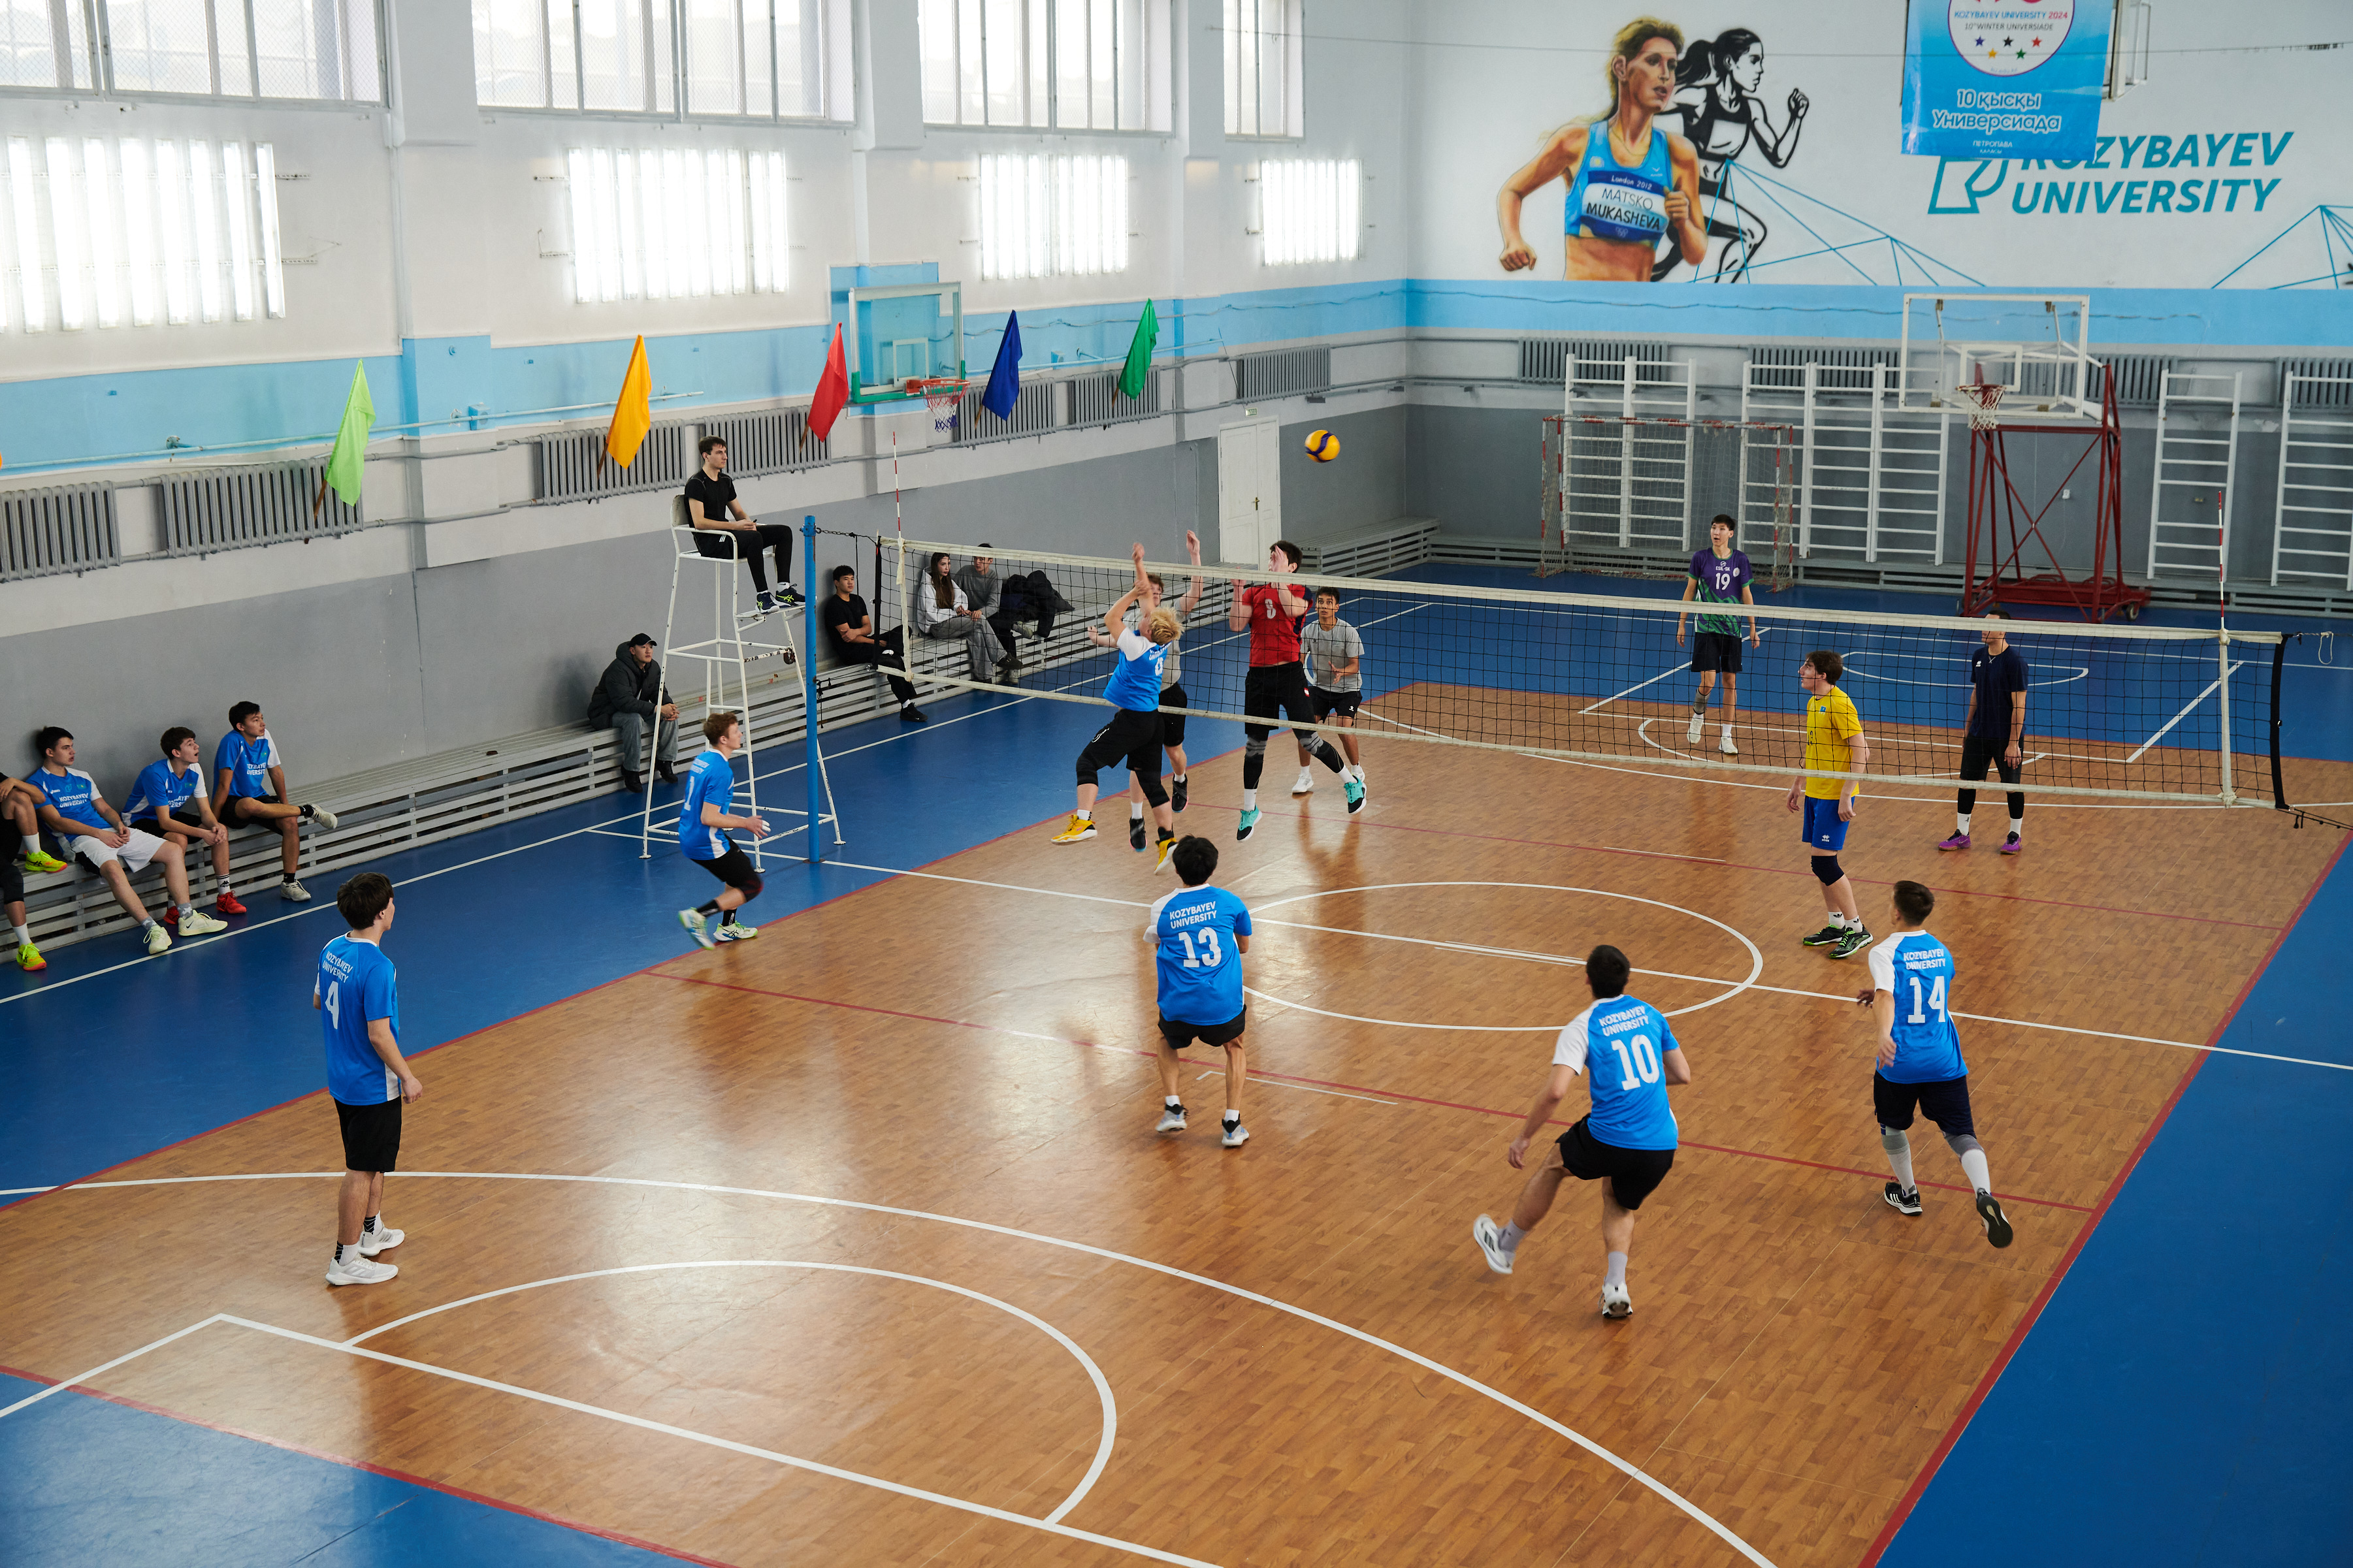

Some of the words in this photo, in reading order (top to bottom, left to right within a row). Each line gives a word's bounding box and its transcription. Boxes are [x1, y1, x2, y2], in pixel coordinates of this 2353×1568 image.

[1955, 10, 1999, 19] KOZYBAYEV
[2048, 11, 2068, 20] 2024
[1958, 89, 1976, 107] 10
[1977, 91, 2041, 111] қысқы
[1932, 109, 2062, 135] Универсиада
[2021, 132, 2294, 169] ZYBAYEV
[1611, 175, 1634, 185] London
[1636, 180, 1652, 190] 2012
[1602, 187, 1653, 210] MATSKO
[2012, 178, 2282, 214] UNIVERSITY
[1586, 202, 1660, 231] MUKASHEVA
[1715, 573, 1730, 590] 19
[1169, 901, 1216, 920] KOZYBAYEV
[1170, 910, 1217, 929] UNIVERSITY
[1178, 927, 1222, 968] 13
[1904, 948, 1944, 961] KOZYBAYEV
[322, 960, 349, 983] UNIVERITY
[1906, 958, 1946, 970] UNIVERSITY
[325, 980, 339, 1030] 4
[1907, 976, 1946, 1023] 14
[1598, 1005, 1646, 1027] KOZYBAYEV
[1602, 1014, 1649, 1036] UNIVERSITY
[1611, 1034, 1660, 1091] 10
